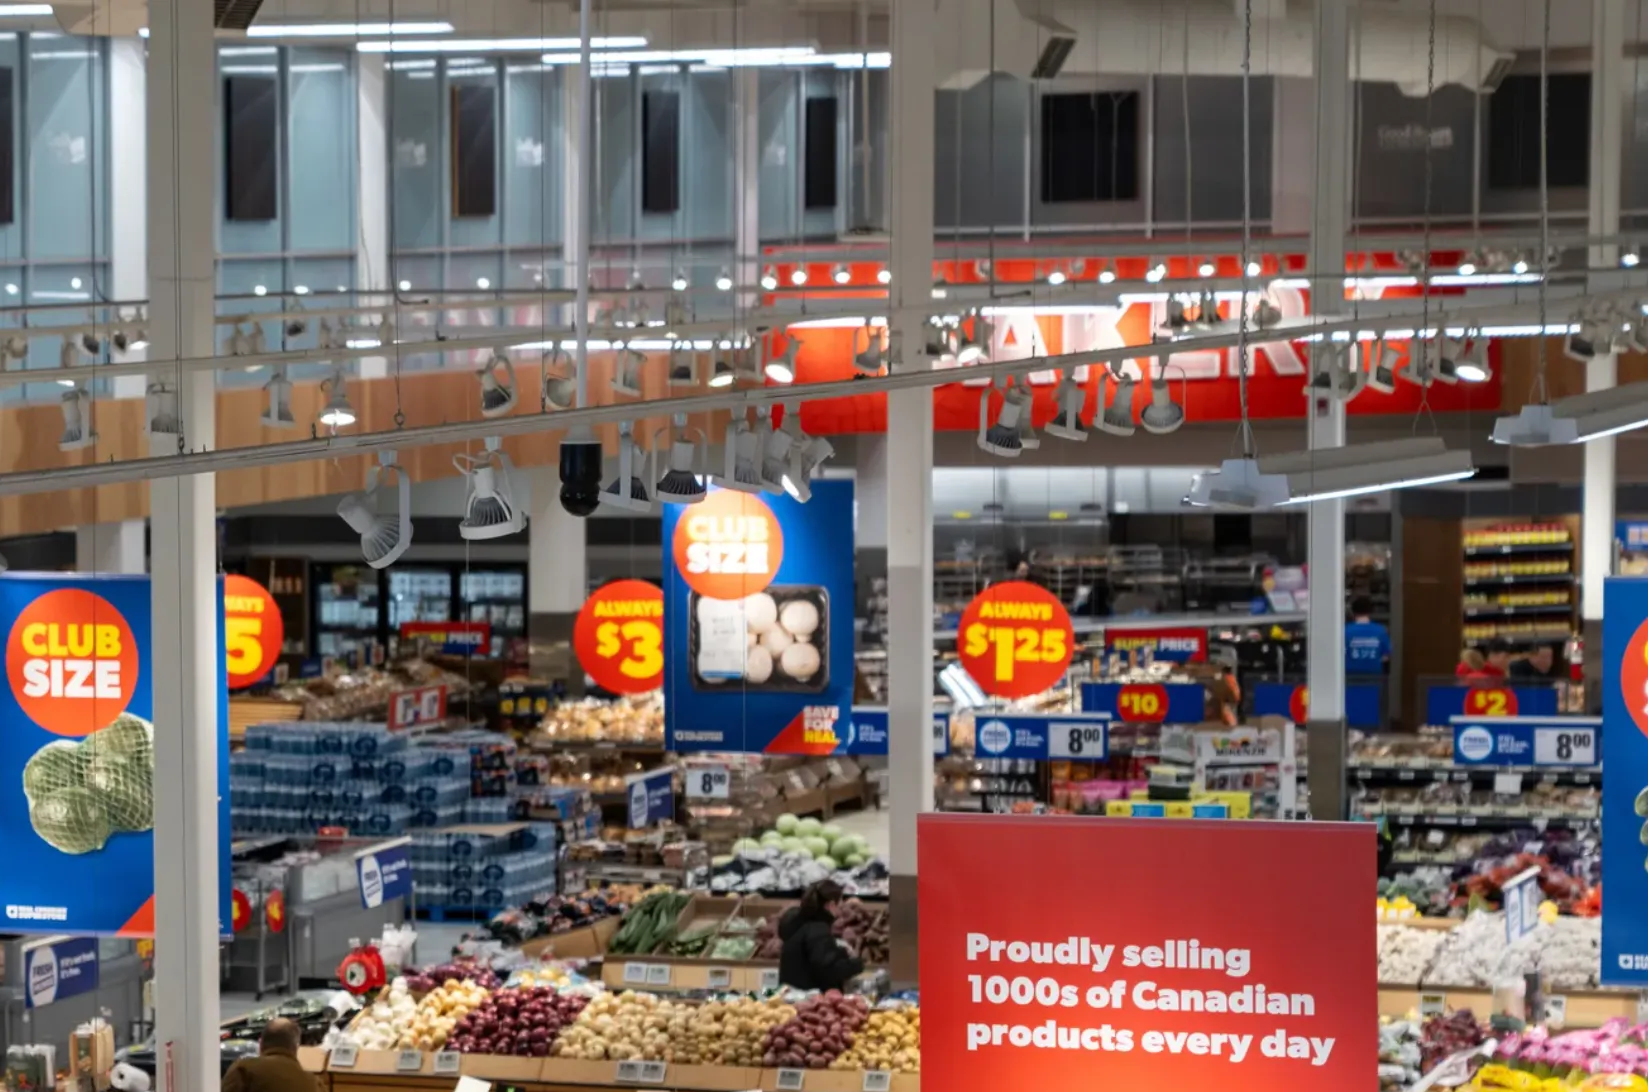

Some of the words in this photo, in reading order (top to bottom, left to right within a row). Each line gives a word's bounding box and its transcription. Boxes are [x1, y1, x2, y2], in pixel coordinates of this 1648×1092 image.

[687, 515, 768, 543] CLUB
[686, 541, 769, 574] SIZE
[979, 601, 1053, 621] ALWAYS
[22, 622, 122, 657] CLUB
[596, 620, 663, 679] $3
[23, 658, 122, 698] SIZE
[1121, 692, 1159, 715] $10
[1474, 691, 1507, 716] $2
[967, 933, 1114, 972] Proudly
[1122, 938, 1251, 977] selling
[968, 974, 1078, 1007] 1000s
[1086, 979, 1126, 1009] of
[1132, 981, 1315, 1016] Canadian
[967, 1019, 1135, 1052] products
[1141, 1030, 1254, 1063] every
[1260, 1029, 1336, 1066] day
